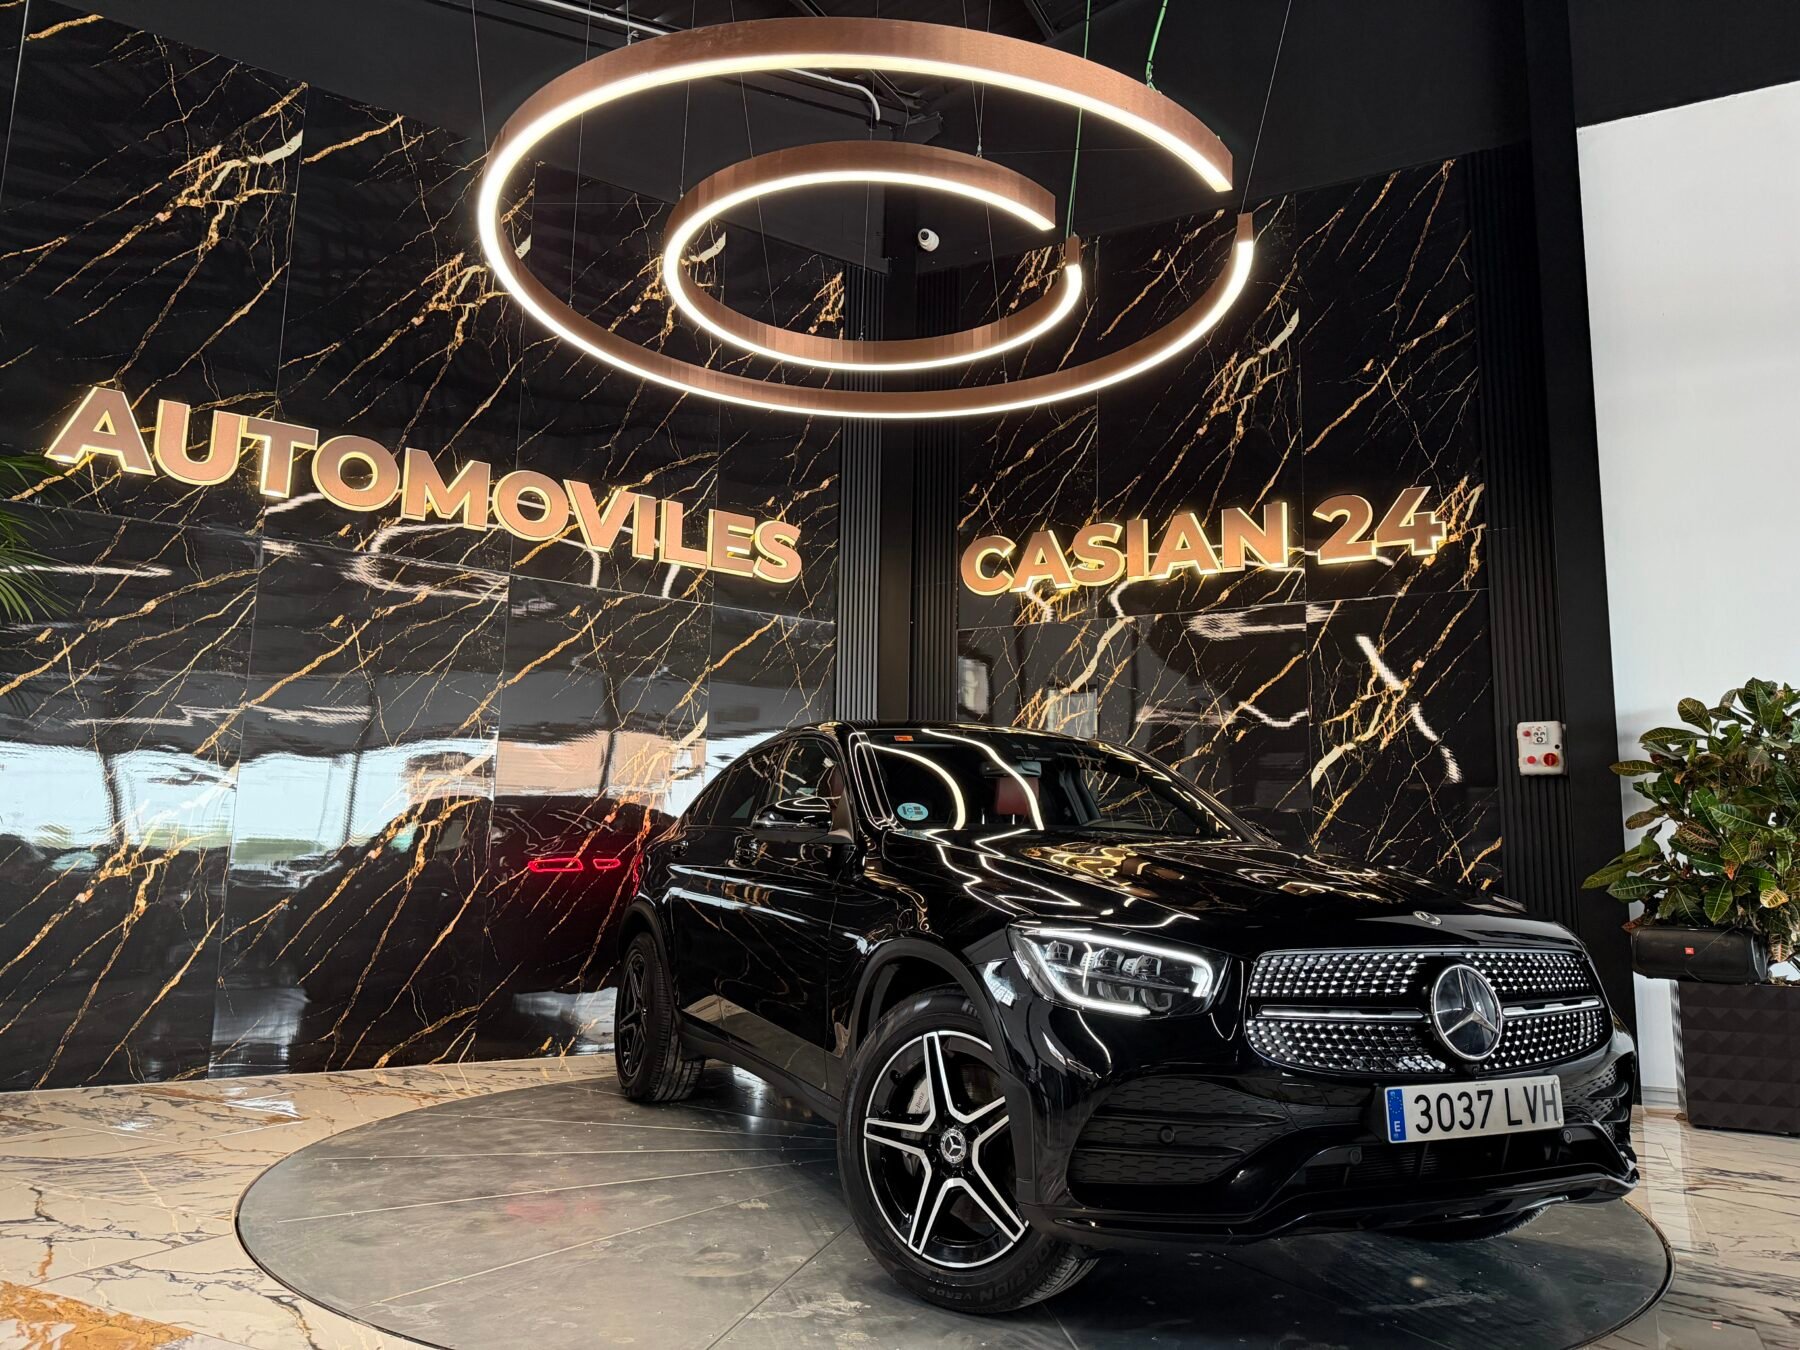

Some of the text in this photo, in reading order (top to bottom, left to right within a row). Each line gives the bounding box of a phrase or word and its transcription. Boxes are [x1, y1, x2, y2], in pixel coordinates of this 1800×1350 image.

[45, 386, 802, 583] AUTOMOVILES
[960, 485, 1447, 596] CASIAN 24
[1393, 1120, 1402, 1132] E
[1414, 1083, 1559, 1134] 3037 LVH
